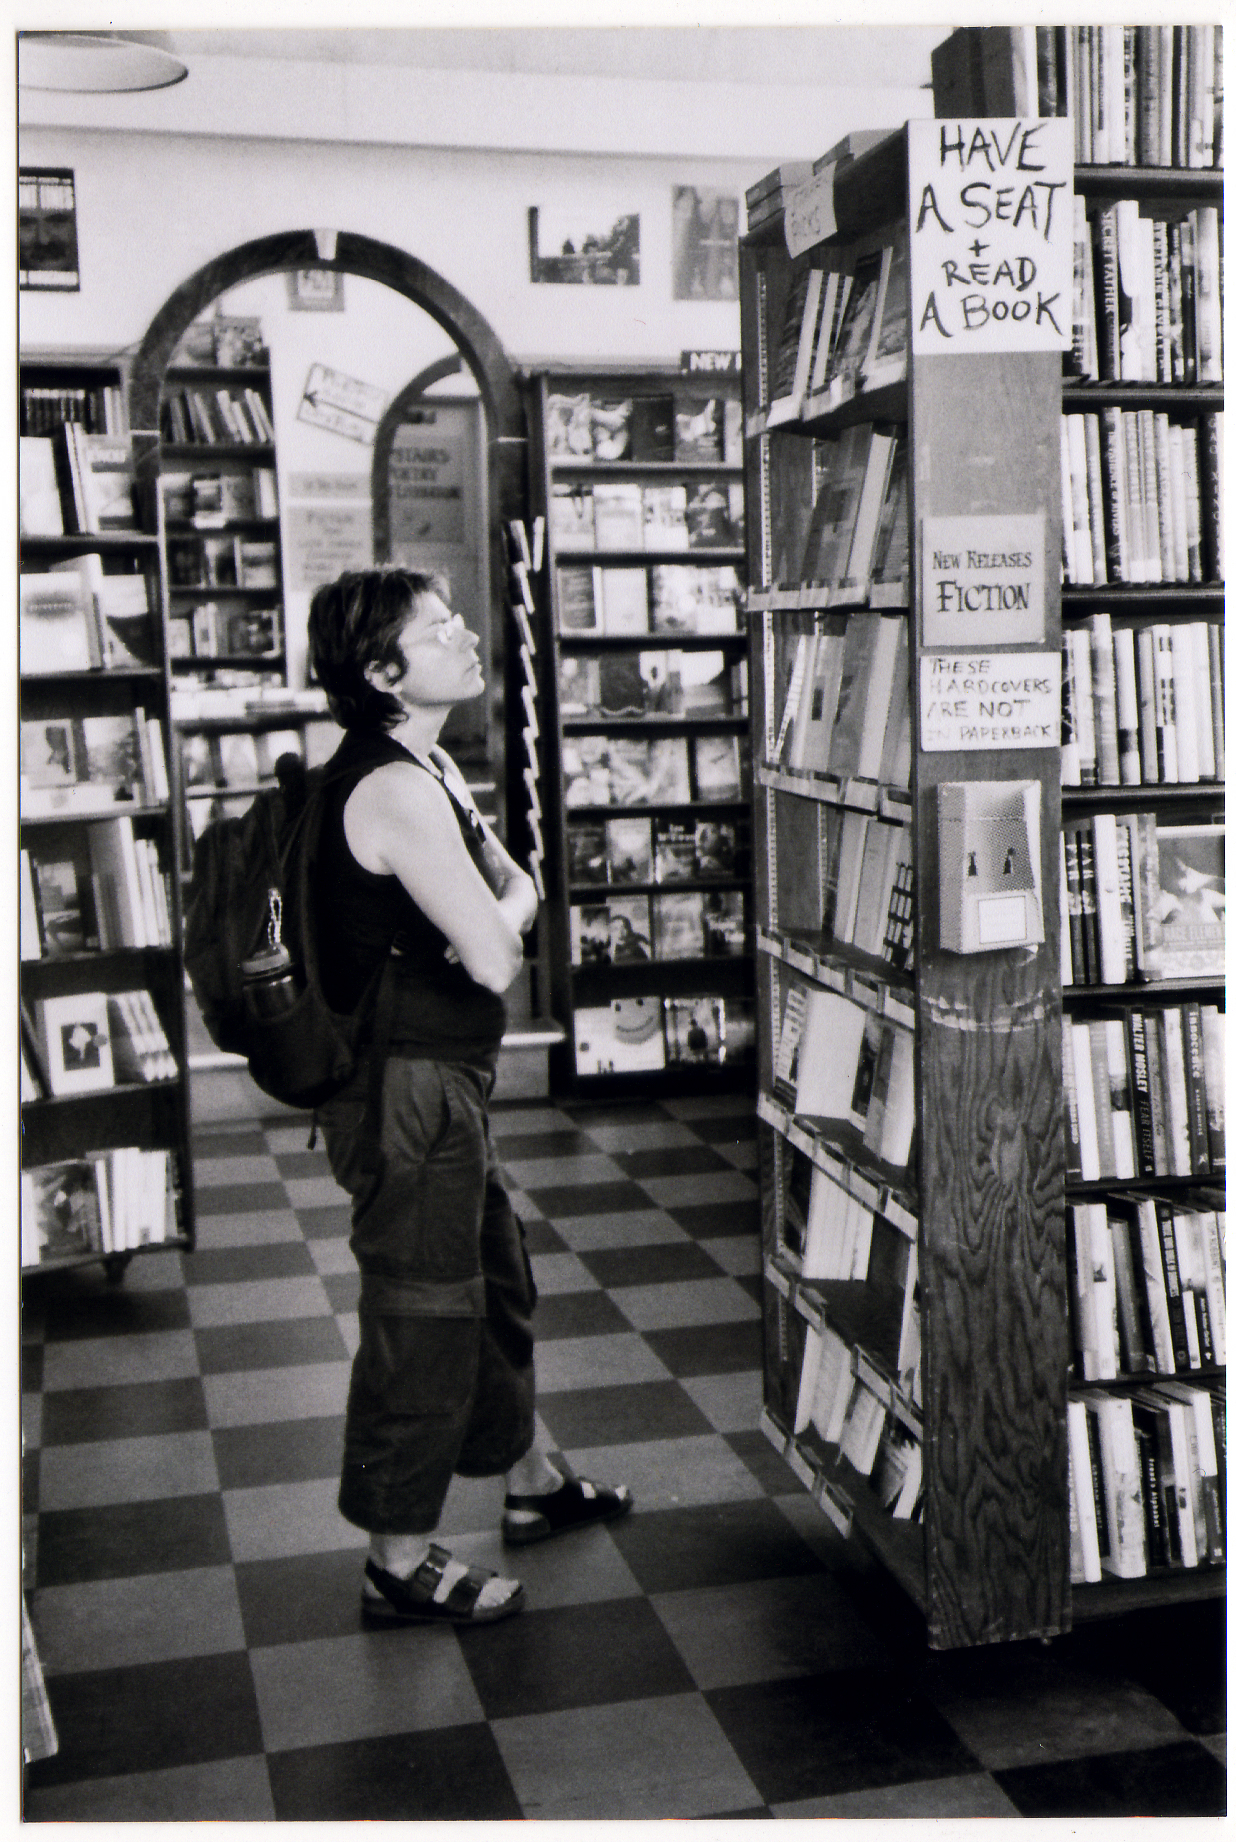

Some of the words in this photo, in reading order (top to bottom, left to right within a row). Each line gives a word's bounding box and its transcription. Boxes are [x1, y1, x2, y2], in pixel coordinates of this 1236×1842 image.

[940, 122, 1047, 172] HAVE
[916, 183, 954, 233] A
[960, 181, 1067, 240] SEAT
[941, 256, 1037, 292] READ
[1104, 263, 1115, 313] FATHER
[920, 290, 954, 338] A
[961, 291, 1063, 336] BOOK
[690, 352, 731, 371] NEW
[936, 580, 1030, 612] FICTION
[930, 658, 991, 675] THESE
[930, 678, 1053, 696] HARDCOVERS
[979, 698, 1031, 718] NOT
[960, 724, 1051, 742] PAPERBACK
[1132, 1013, 1145, 1051] WALTER
[1135, 1053, 1148, 1093] MOSLEY
[1140, 1100, 1151, 1125] FEAR
[1143, 1128, 1154, 1159] ITSELF
